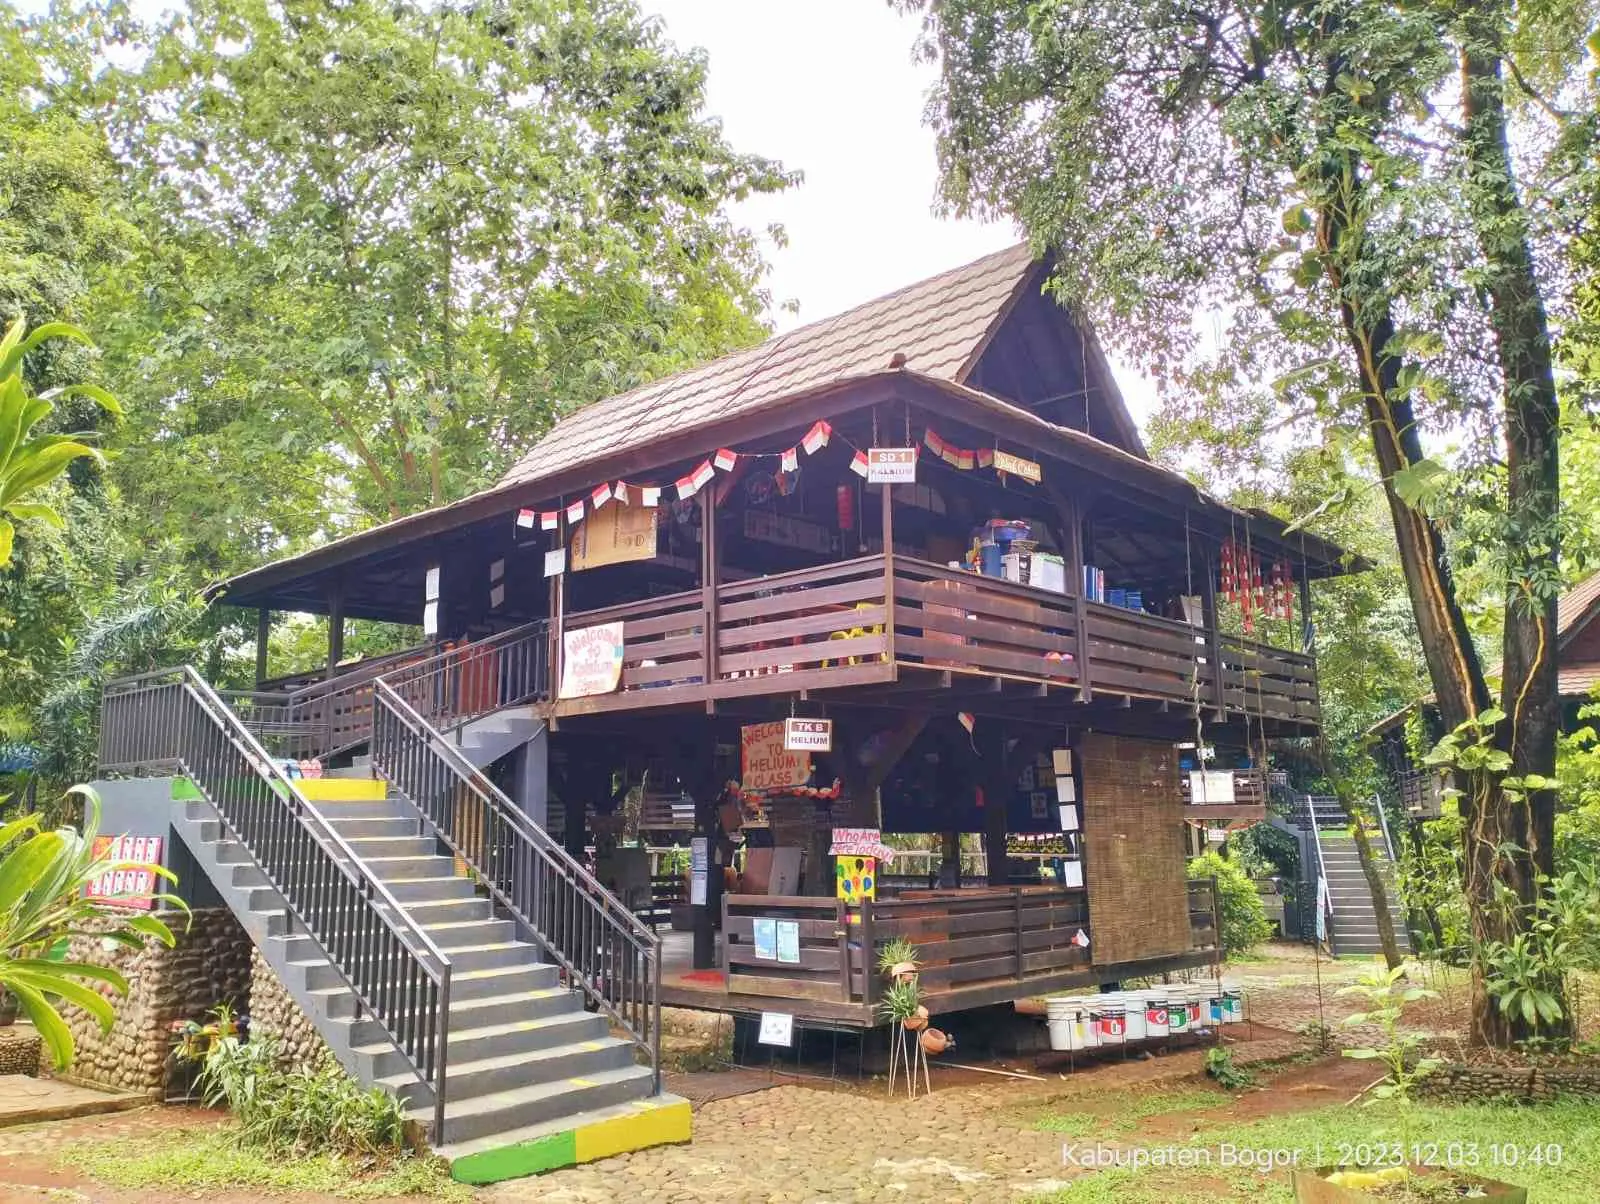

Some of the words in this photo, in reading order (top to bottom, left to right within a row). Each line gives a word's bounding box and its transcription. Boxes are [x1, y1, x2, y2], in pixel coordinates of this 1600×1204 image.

[879, 452, 896, 462] SD
[900, 452, 905, 462] 1
[797, 723, 813, 732] TK
[816, 723, 824, 732] B
[791, 736, 828, 745] HELIUM
[767, 743, 783, 756] TO
[750, 756, 796, 772] HELIUM
[753, 771, 793, 787] CLASS
[834, 830, 860, 842] Who
[861, 831, 880, 841] Are
